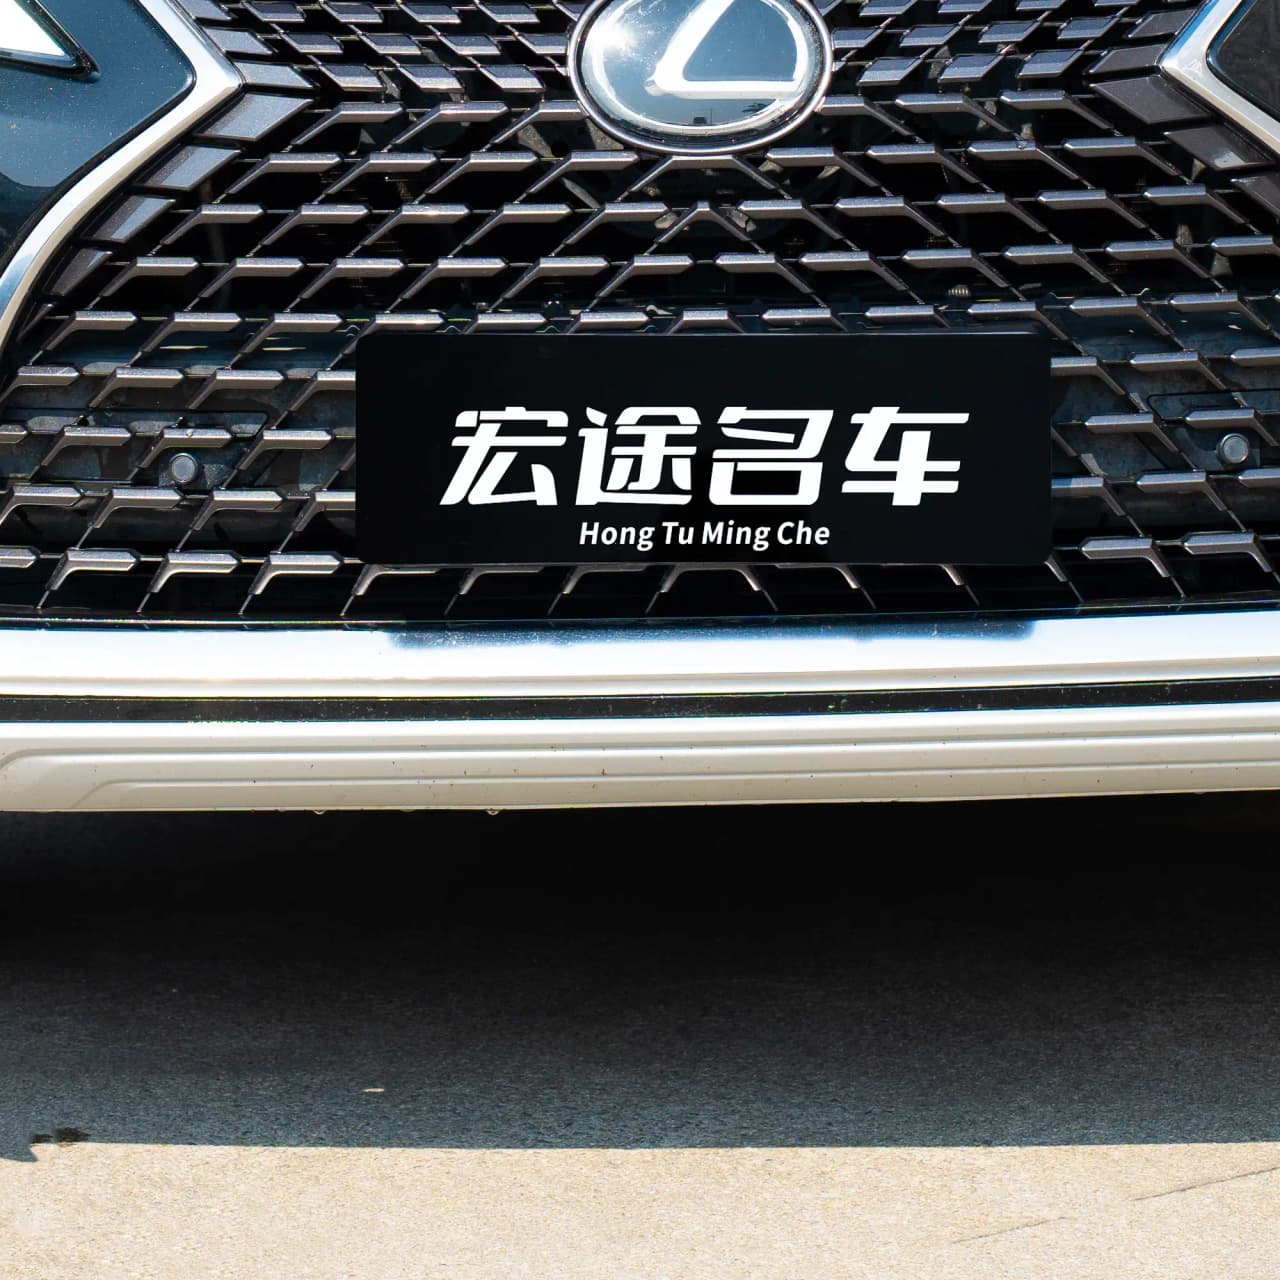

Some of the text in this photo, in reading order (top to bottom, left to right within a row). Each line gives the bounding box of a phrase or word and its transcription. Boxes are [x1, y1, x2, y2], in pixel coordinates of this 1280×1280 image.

[439, 406, 970, 506] 宏途名车
[579, 519, 830, 552] Hong Tu Ming Che
